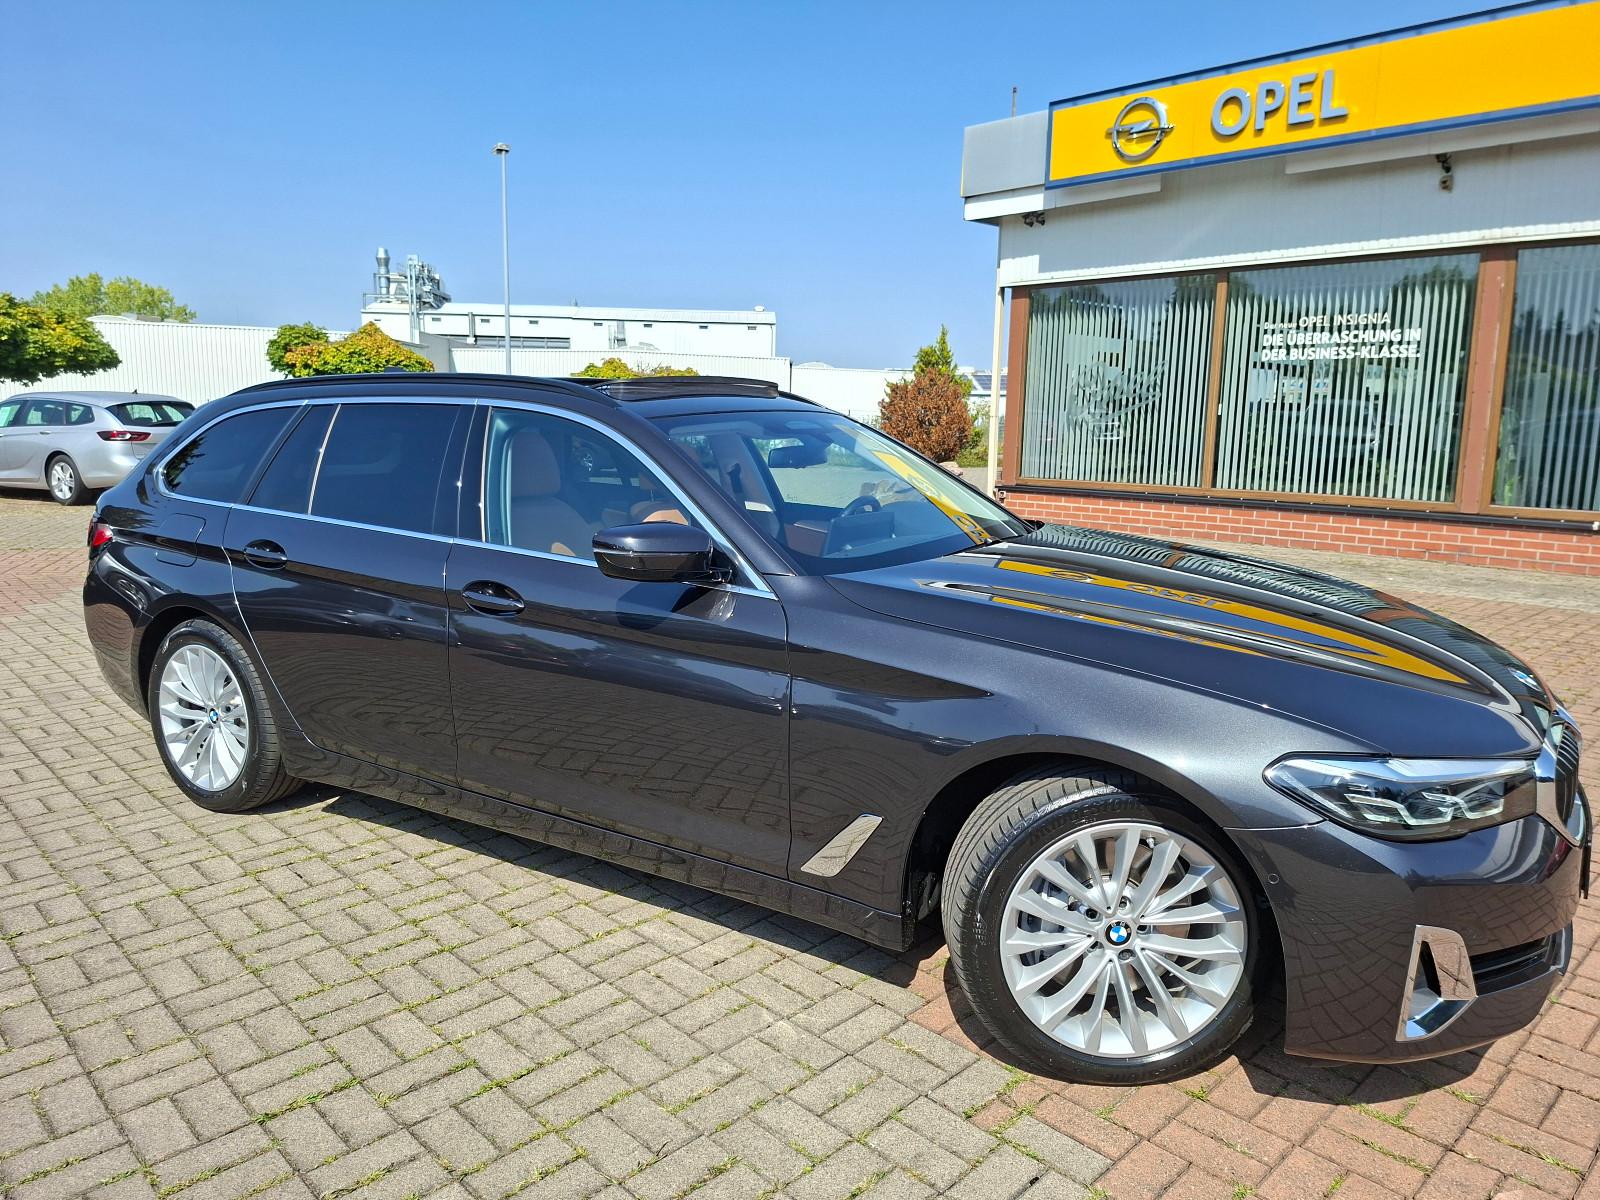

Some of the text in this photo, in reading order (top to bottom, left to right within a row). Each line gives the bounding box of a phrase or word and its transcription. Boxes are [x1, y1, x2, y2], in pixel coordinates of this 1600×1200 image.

[1211, 69, 1349, 136] OPEL
[1299, 315, 1331, 328] OPEL
[1333, 312, 1391, 326] INSIGNIA
[1263, 327, 1422, 347] DIE ÜBERRASCHUNG IN
[1261, 344, 1421, 362] DER BUSINESS-KLASSE.
